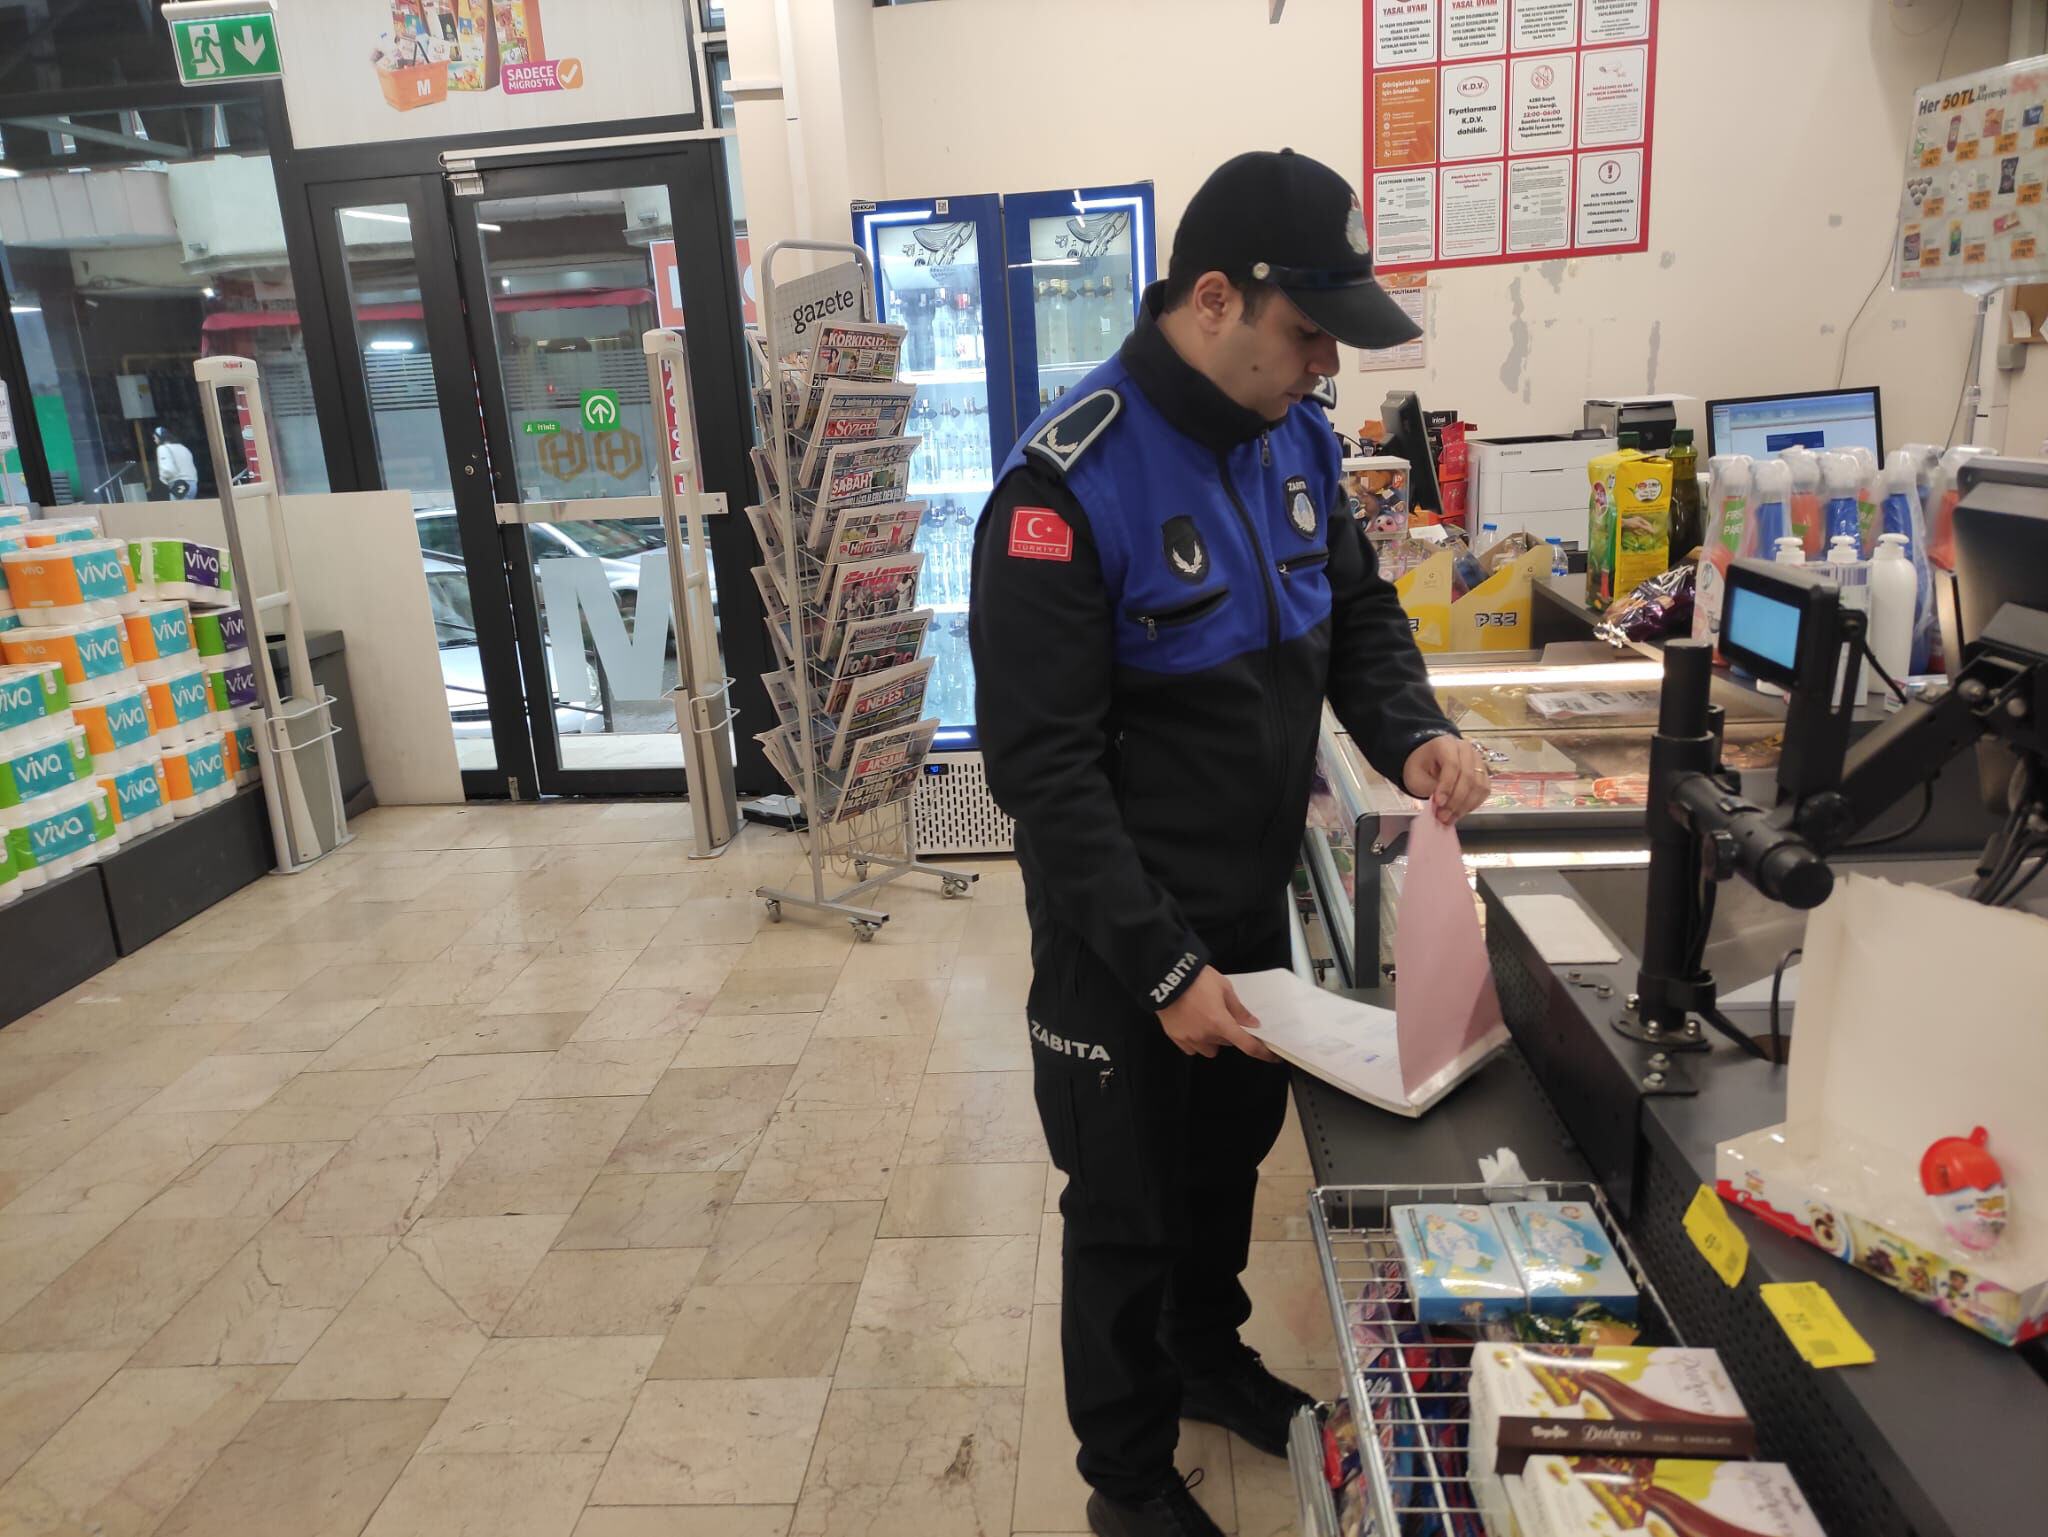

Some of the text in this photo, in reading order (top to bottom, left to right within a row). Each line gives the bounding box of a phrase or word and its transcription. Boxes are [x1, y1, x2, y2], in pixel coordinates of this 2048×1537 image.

[1383, 4, 1427, 16] YASAL UYARI
[507, 65, 554, 81] SADECE
[417, 79, 431, 96] M
[1462, 82, 1486, 91] K.D.V.
[1448, 105, 1497, 115] Fiyatlarımıza
[1918, 98, 1940, 116] Her
[1457, 126, 1488, 136] dahildir.
[1461, 116, 1484, 124] K.D.V.
[793, 290, 854, 334] gazete
[832, 472, 870, 494] SABAH
[76, 561, 122, 585] viva
[185, 549, 219, 574] viva
[153, 618, 188, 641] viva
[1475, 612, 1517, 627] PEZ
[79, 637, 120, 663] viva
[0, 686, 32, 712] iva
[172, 684, 206, 709] viva
[865, 689, 904, 713] NEFES
[108, 706, 146, 732] viva
[16, 753, 62, 784] viva
[190, 752, 223, 778] viva
[118, 776, 159, 804] viva
[34, 816, 84, 848] viva
[1150, 952, 1199, 1003] ZABITA
[1031, 1020, 1111, 1061] ZABITA
